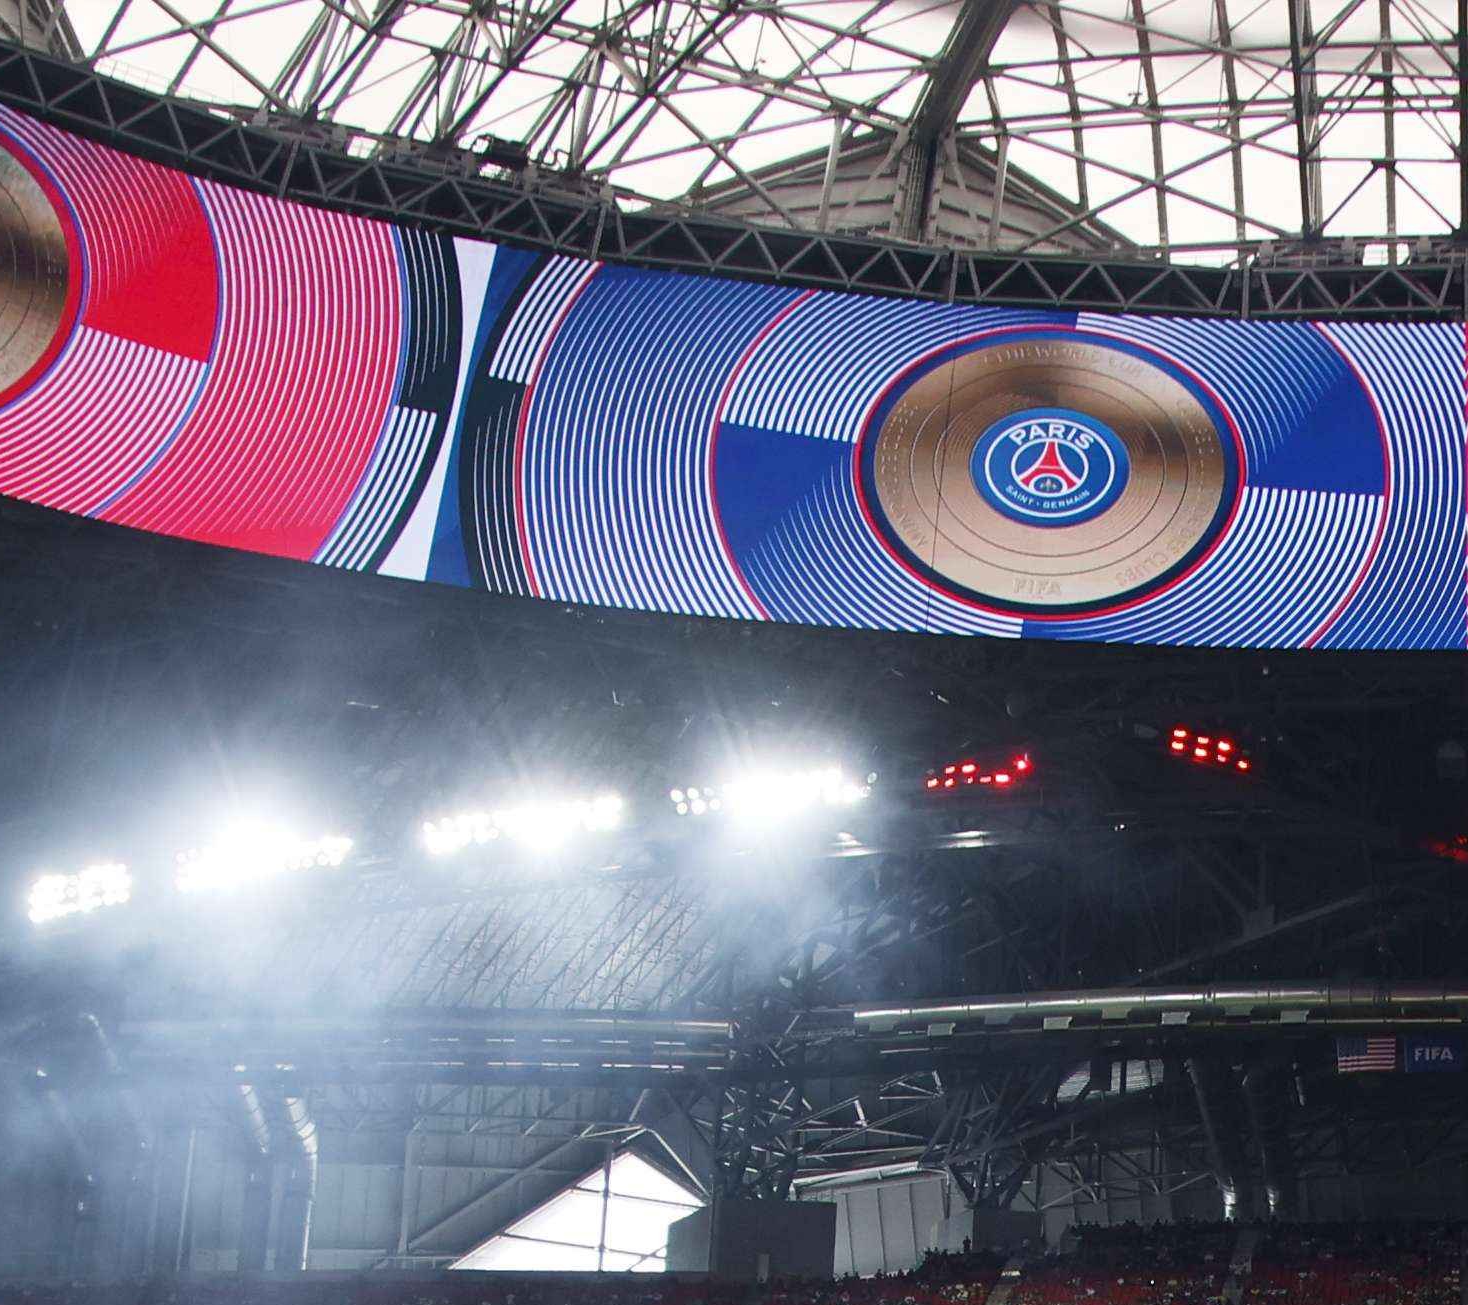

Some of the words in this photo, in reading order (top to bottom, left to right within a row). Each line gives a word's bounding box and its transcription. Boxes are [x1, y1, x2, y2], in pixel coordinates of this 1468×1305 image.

[1009, 423, 1095, 451] PARIS
[1005, 484, 1034, 506] SAINT
[1042, 489, 1091, 509] GERMAIN
[1414, 1046, 1453, 1062] FIFA
